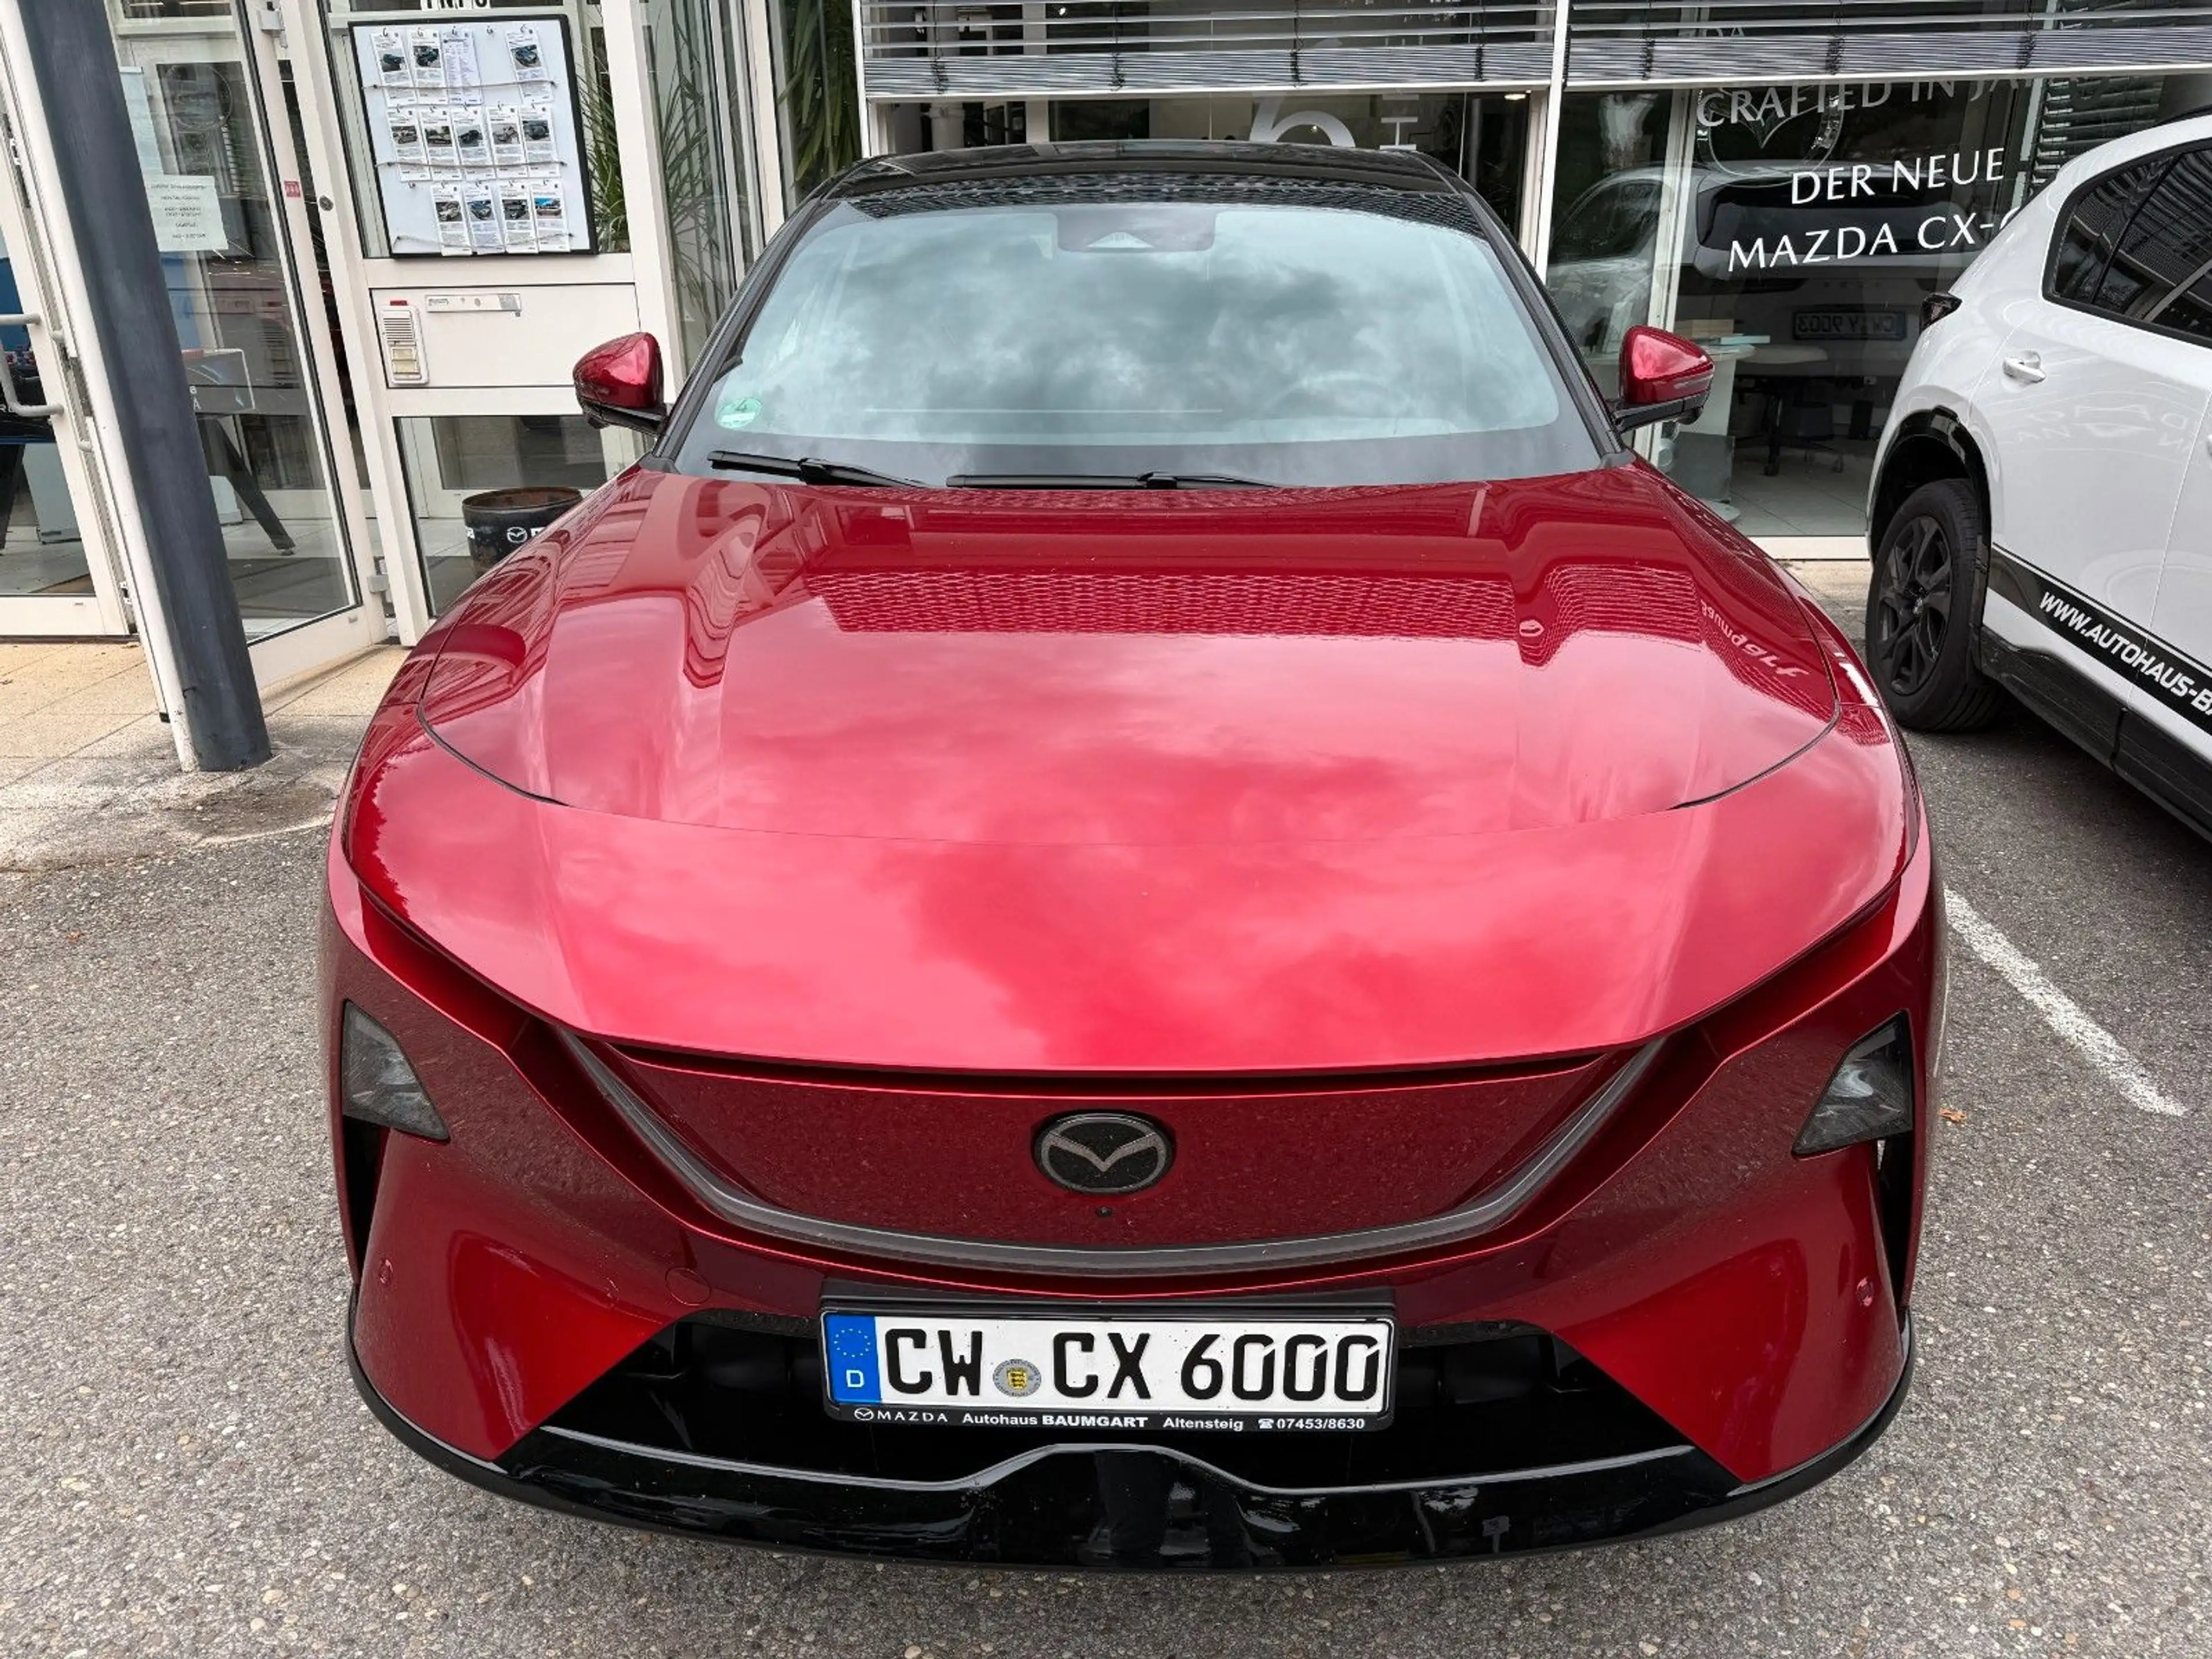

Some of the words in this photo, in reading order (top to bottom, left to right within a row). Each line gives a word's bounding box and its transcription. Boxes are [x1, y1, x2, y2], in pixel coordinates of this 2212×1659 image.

[1792, 165, 1876, 204] DER
[1892, 148, 2004, 192] NEUE
[1728, 223, 1898, 272] MAZDA
[846, 1369, 865, 1388] D
[885, 1328, 983, 1396] CW
[1053, 1332, 1152, 1400] CX
[1181, 1334, 1380, 1402] 6000
[877, 1410, 948, 1422] MAZDA
[962, 1412, 1038, 1425] Autohaus
[1042, 1415, 1149, 1428] BAUMGART
[1162, 1417, 1244, 1431] Altensteig
[1277, 1418, 1365, 1430] 07453/8630
